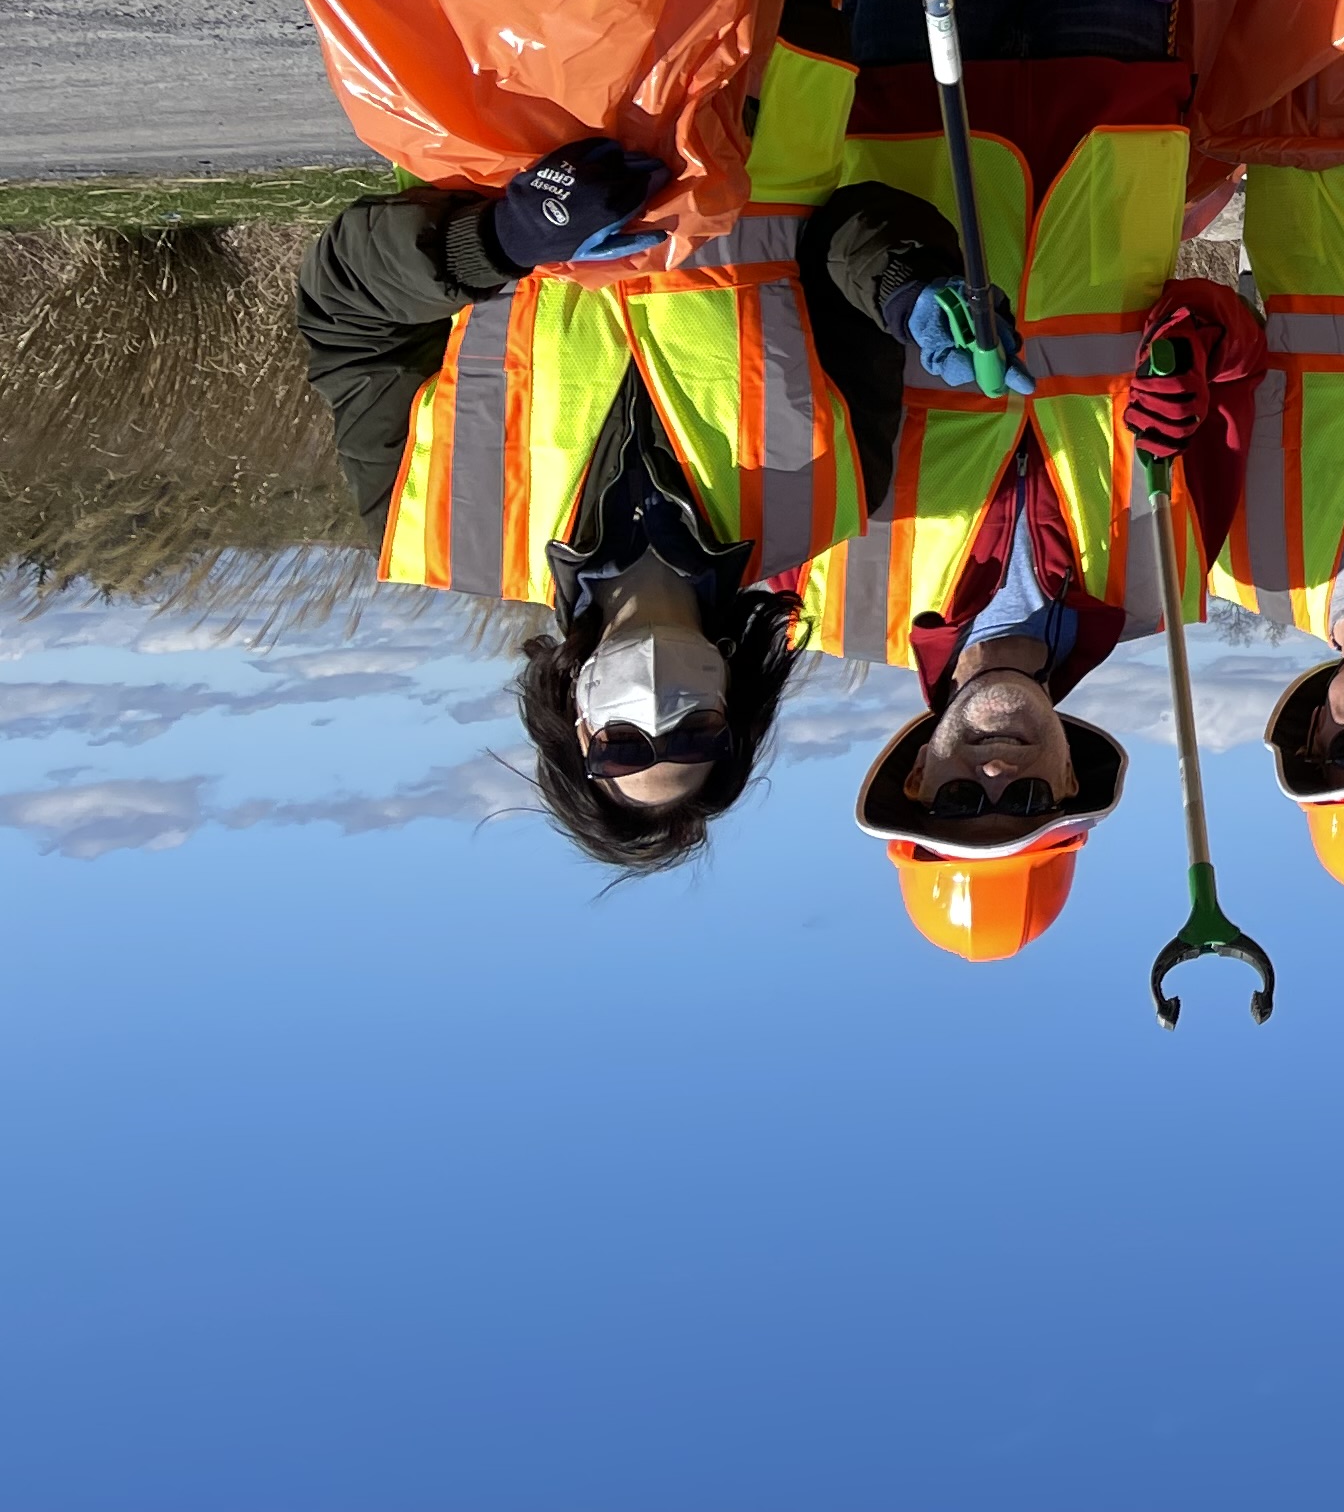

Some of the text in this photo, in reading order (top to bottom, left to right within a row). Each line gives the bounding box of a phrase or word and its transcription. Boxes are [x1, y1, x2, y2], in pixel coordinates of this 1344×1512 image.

[559, 160, 576, 174] XL
[536, 168, 575, 187] GRIP
[530, 178, 571, 201] Frosty
